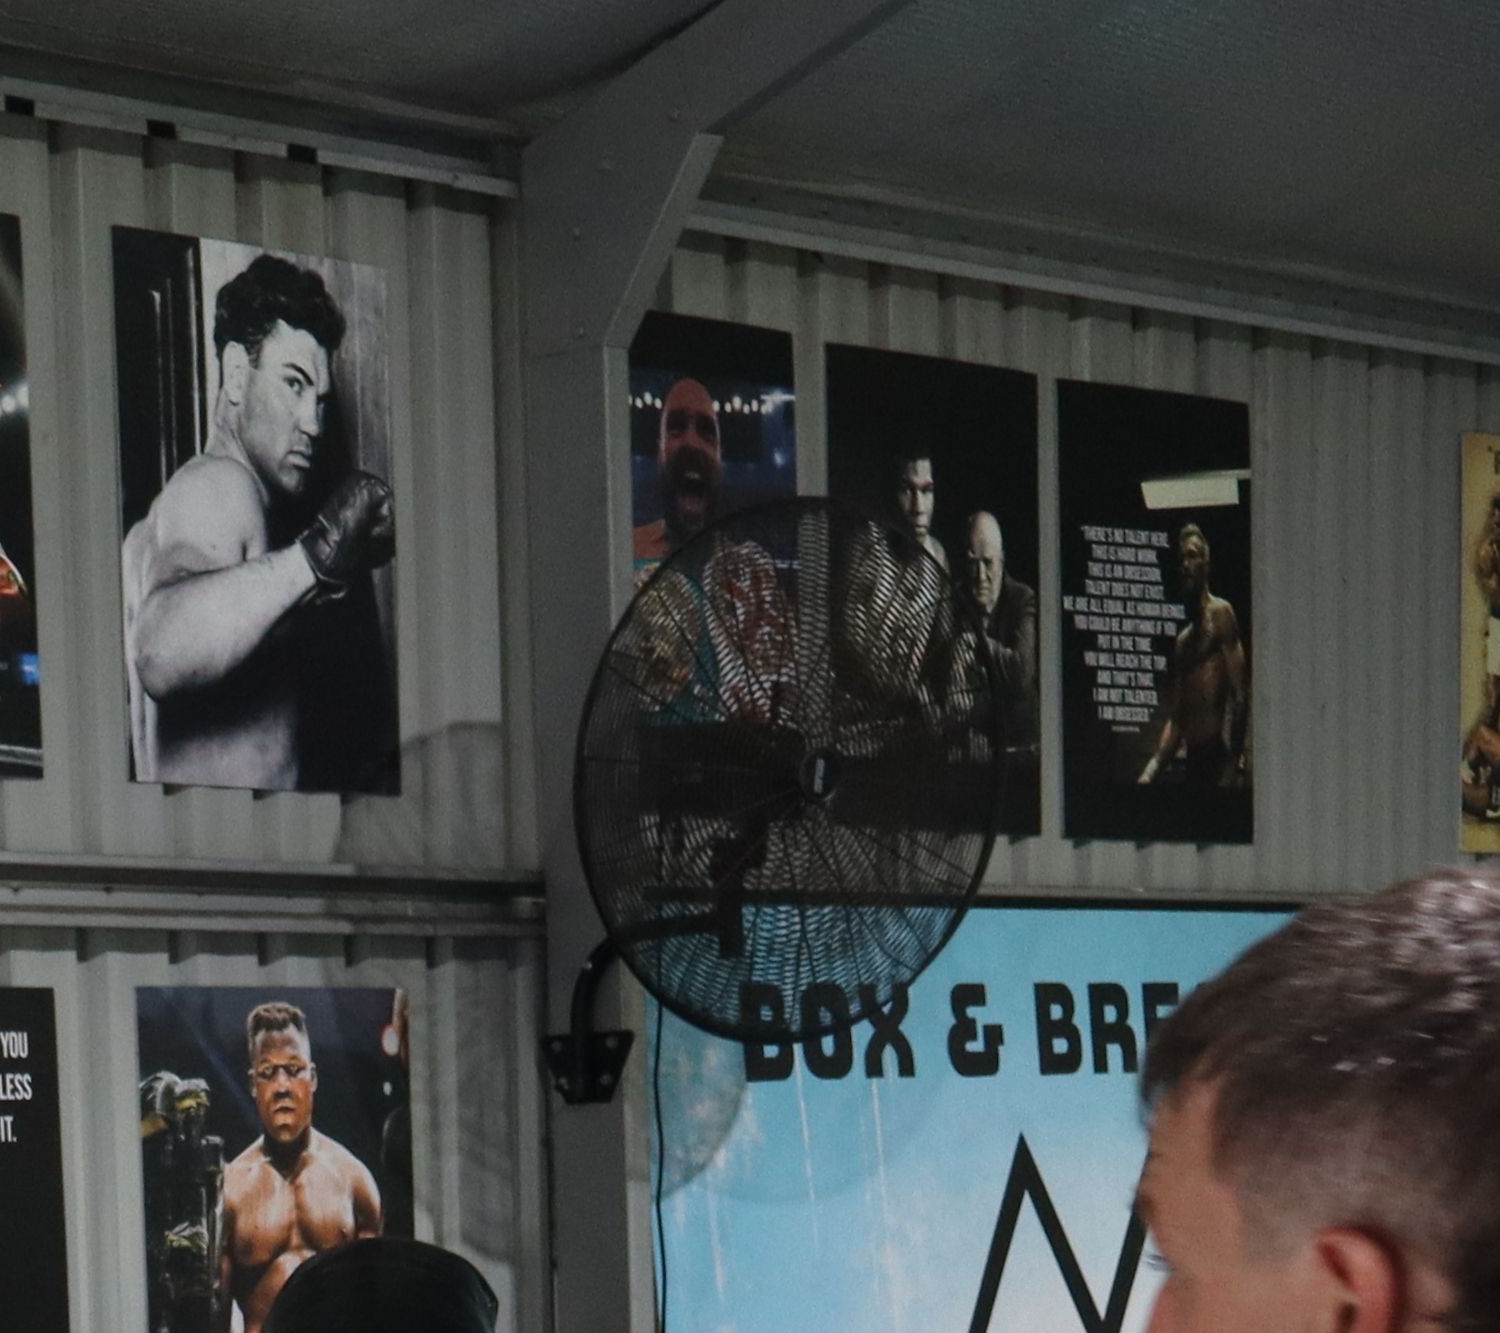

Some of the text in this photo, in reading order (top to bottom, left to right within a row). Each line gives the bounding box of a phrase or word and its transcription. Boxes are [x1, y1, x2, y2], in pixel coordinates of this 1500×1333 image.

[0, 1031, 29, 1059] YOU
[739, 981, 916, 1083] BOX
[947, 983, 1005, 1077] &
[0, 1116, 18, 1143] IT.
